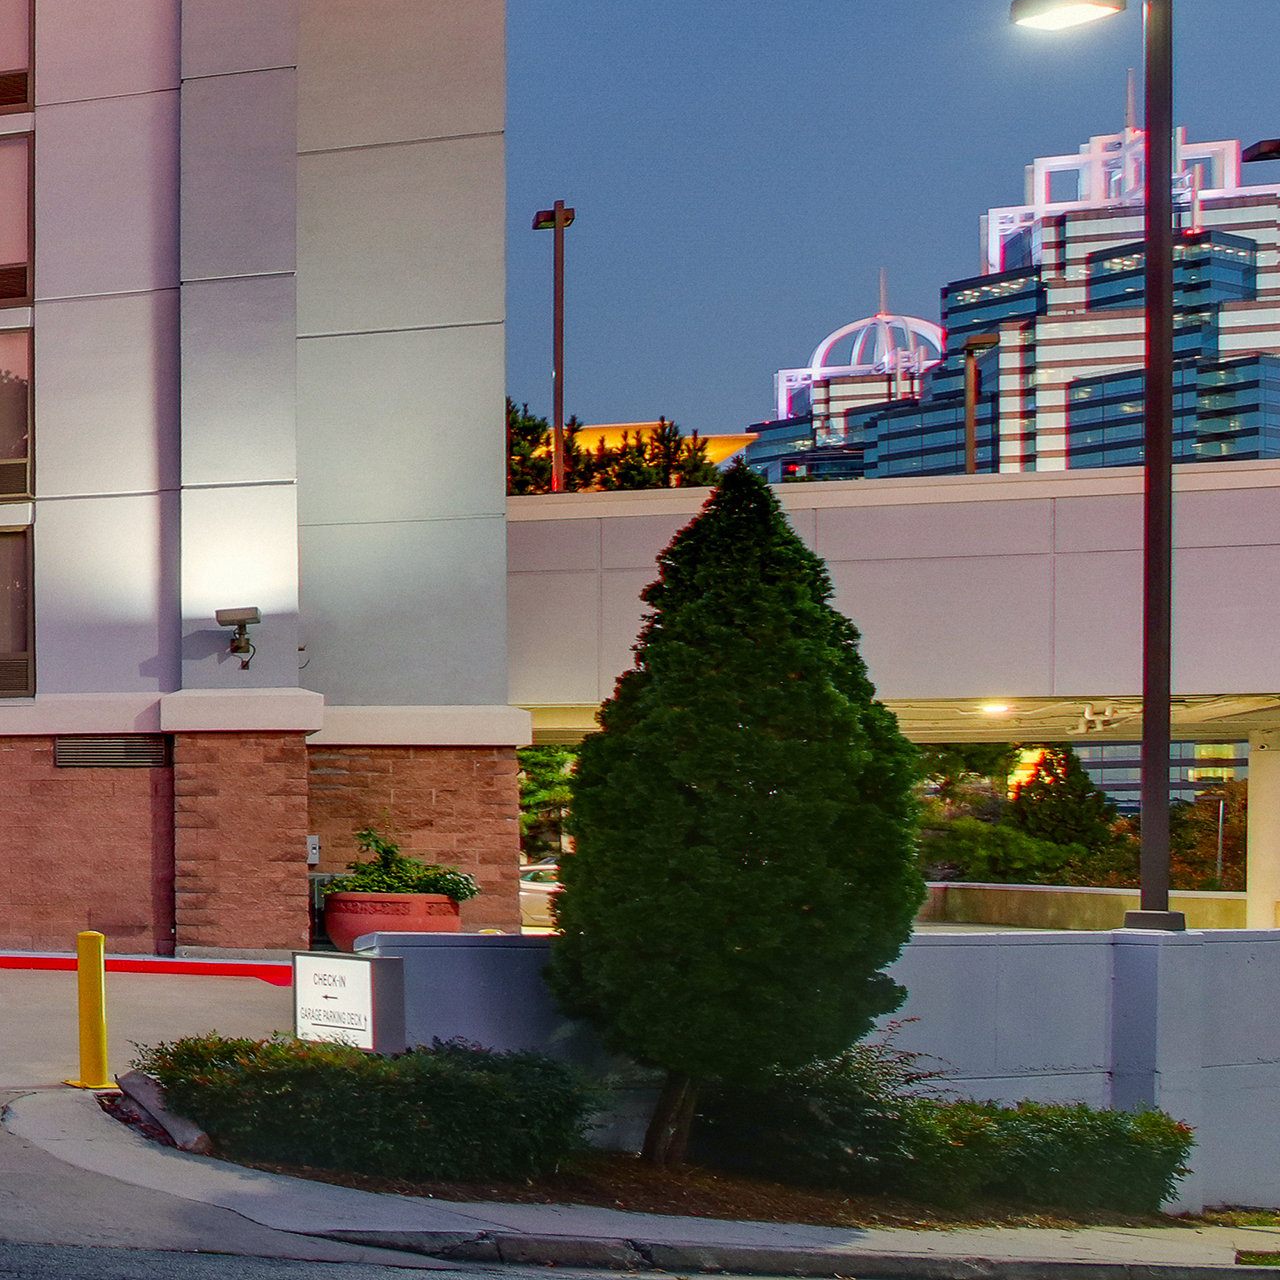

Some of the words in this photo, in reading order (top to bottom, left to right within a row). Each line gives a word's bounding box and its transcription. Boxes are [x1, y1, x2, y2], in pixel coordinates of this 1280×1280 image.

[313, 972, 346, 988] CHECK-IN
[300, 1007, 322, 1022] GARAGE
[323, 1009, 346, 1025] PARKING
[347, 1011, 362, 1027] DECK
